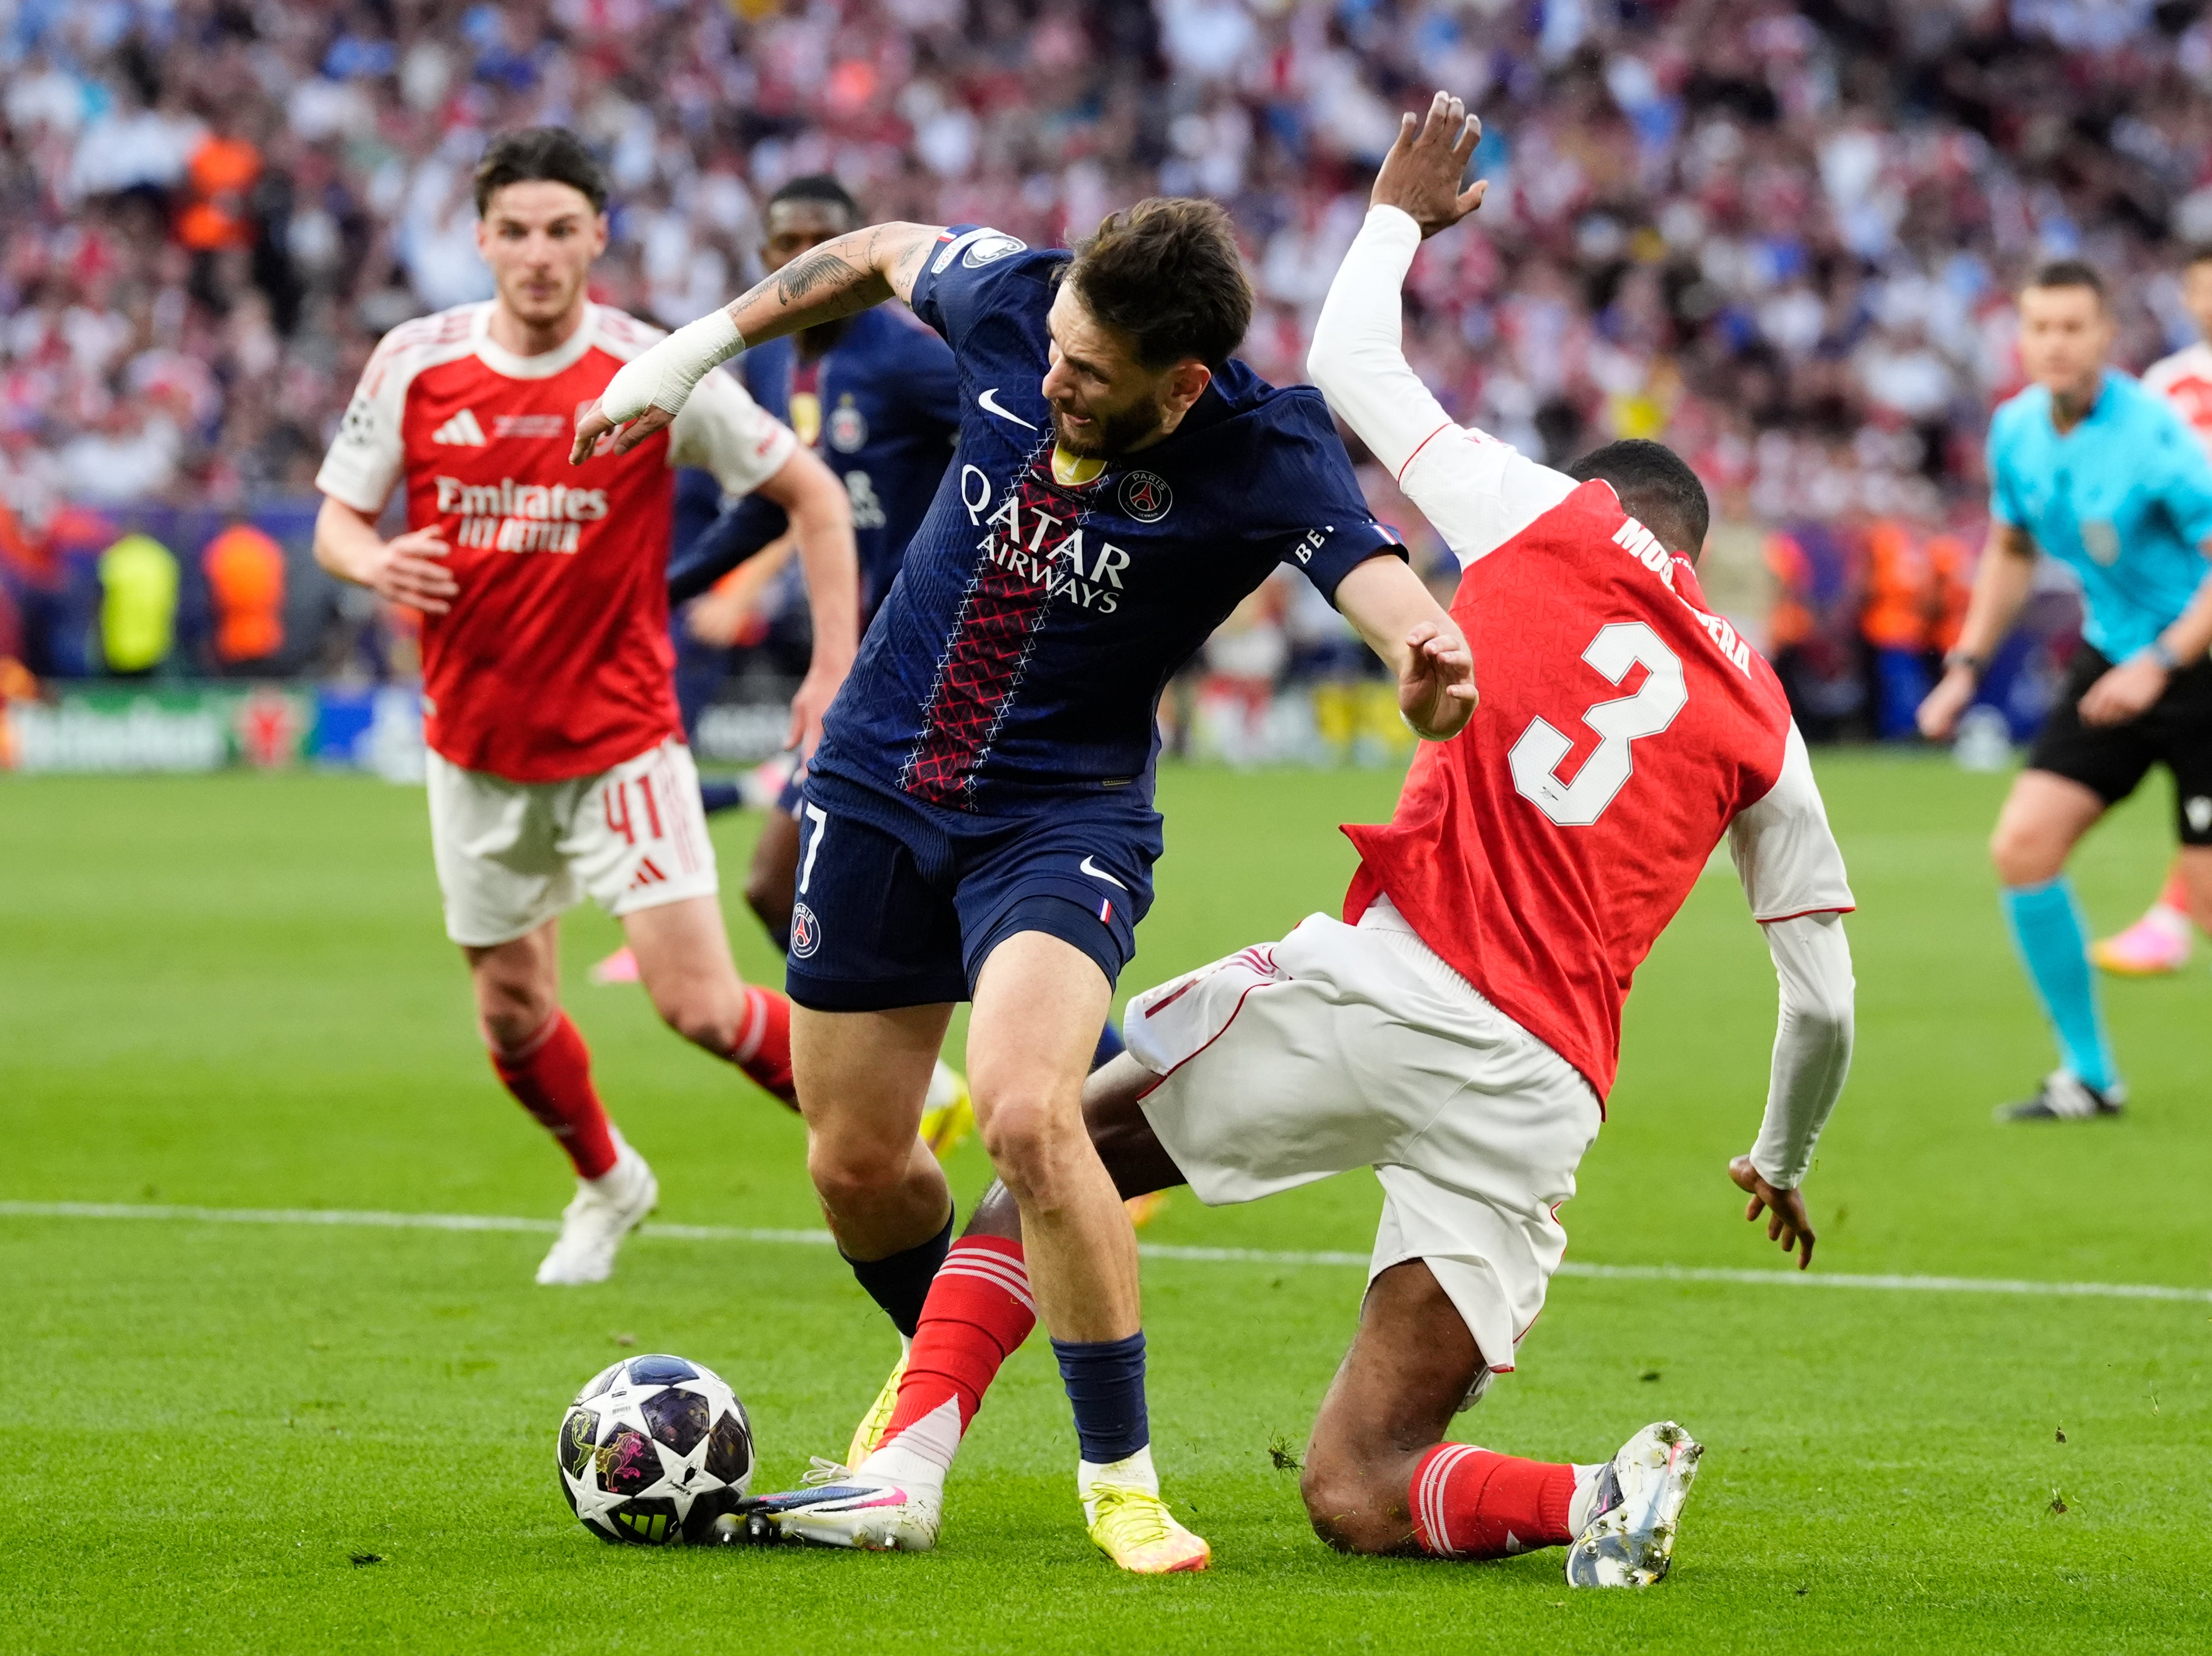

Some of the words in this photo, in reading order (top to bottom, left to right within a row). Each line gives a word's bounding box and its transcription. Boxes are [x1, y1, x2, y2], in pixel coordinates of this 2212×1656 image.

[434, 475, 608, 520] Emirates
[1132, 473, 1166, 491] PARIS
[961, 464, 1130, 589] QATAR
[976, 533, 1119, 613] AIRWAYS
[1507, 621, 1689, 826] 3
[602, 773, 663, 845] 41
[799, 802, 827, 894] 7
[795, 905, 814, 923] PARIS
